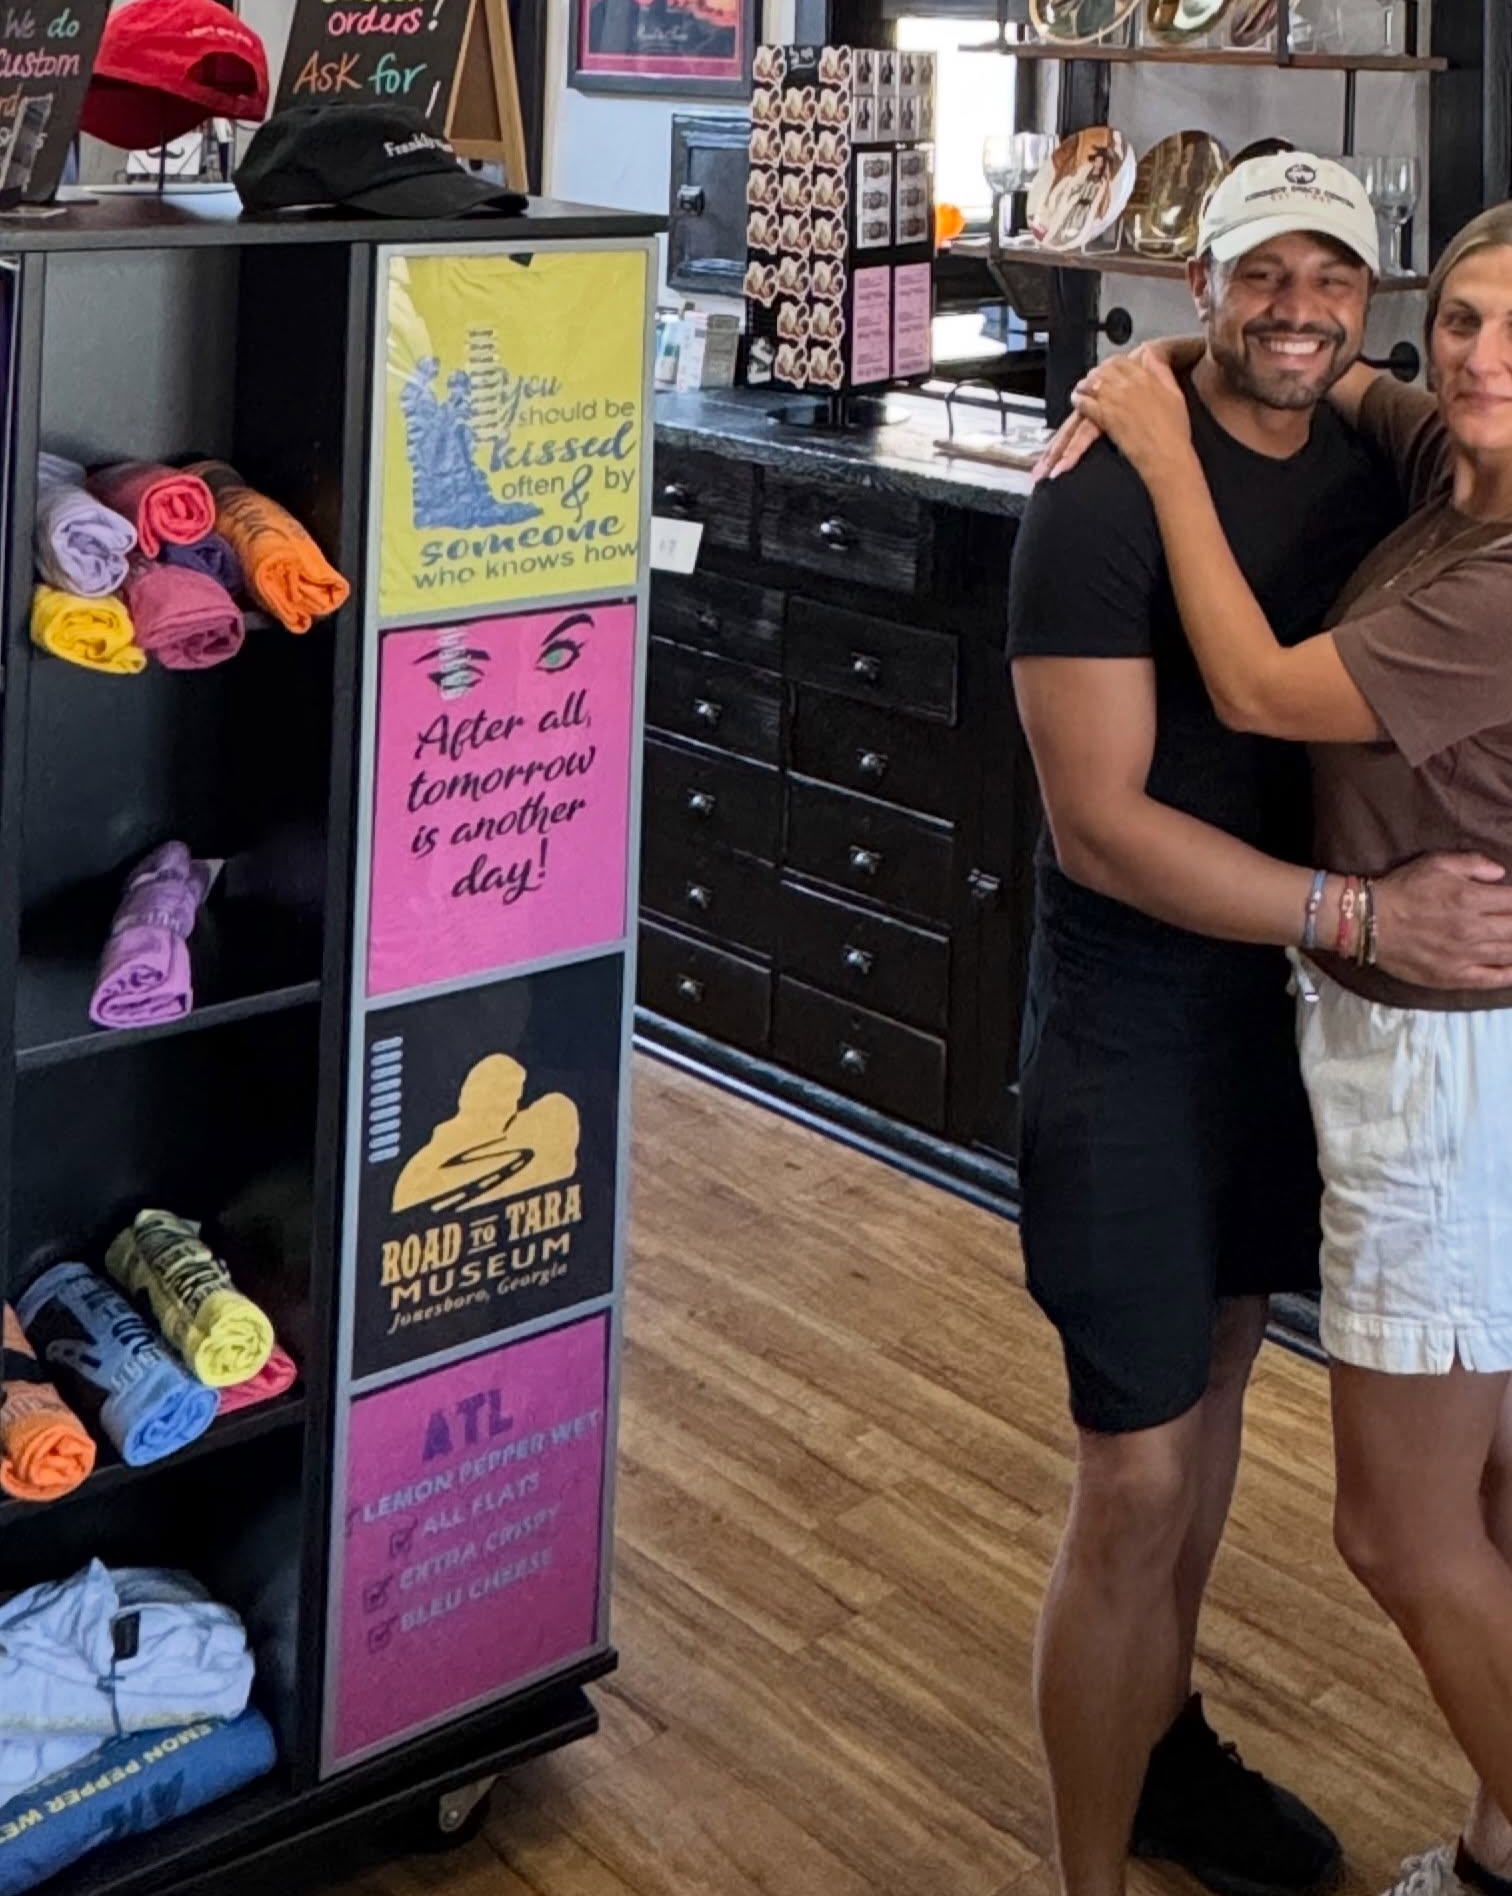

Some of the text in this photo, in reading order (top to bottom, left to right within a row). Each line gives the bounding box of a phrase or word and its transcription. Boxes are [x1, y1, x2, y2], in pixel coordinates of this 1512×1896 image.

[2, 8, 80, 39] We do
[368, 53, 428, 94] for
[519, 399, 636, 427] should be
[489, 421, 637, 473] kissed
[502, 476, 565, 501] often
[604, 466, 636, 493] by
[413, 564, 475, 590] who
[487, 549, 574, 580] knows
[584, 539, 640, 564] how
[419, 514, 625, 567] someone
[413, 709, 524, 761] After
[407, 745, 596, 813] tomorrow
[411, 791, 586, 858] is another
[451, 837, 549, 904] day!
[380, 1184, 583, 1287] ROAD TO TARA
[389, 1232, 571, 1311] MUSEUM
[497, 1261, 569, 1296] Georgia
[422, 1388, 515, 1462] ATL
[361, 1408, 602, 1525] LEMON PEPPER WET
[422, 1472, 541, 1538] ALL FLATS
[399, 1544, 477, 1590] EXTRA
[142, 1721, 216, 1764] EMON
[45, 1759, 142, 1814] PEPPER
